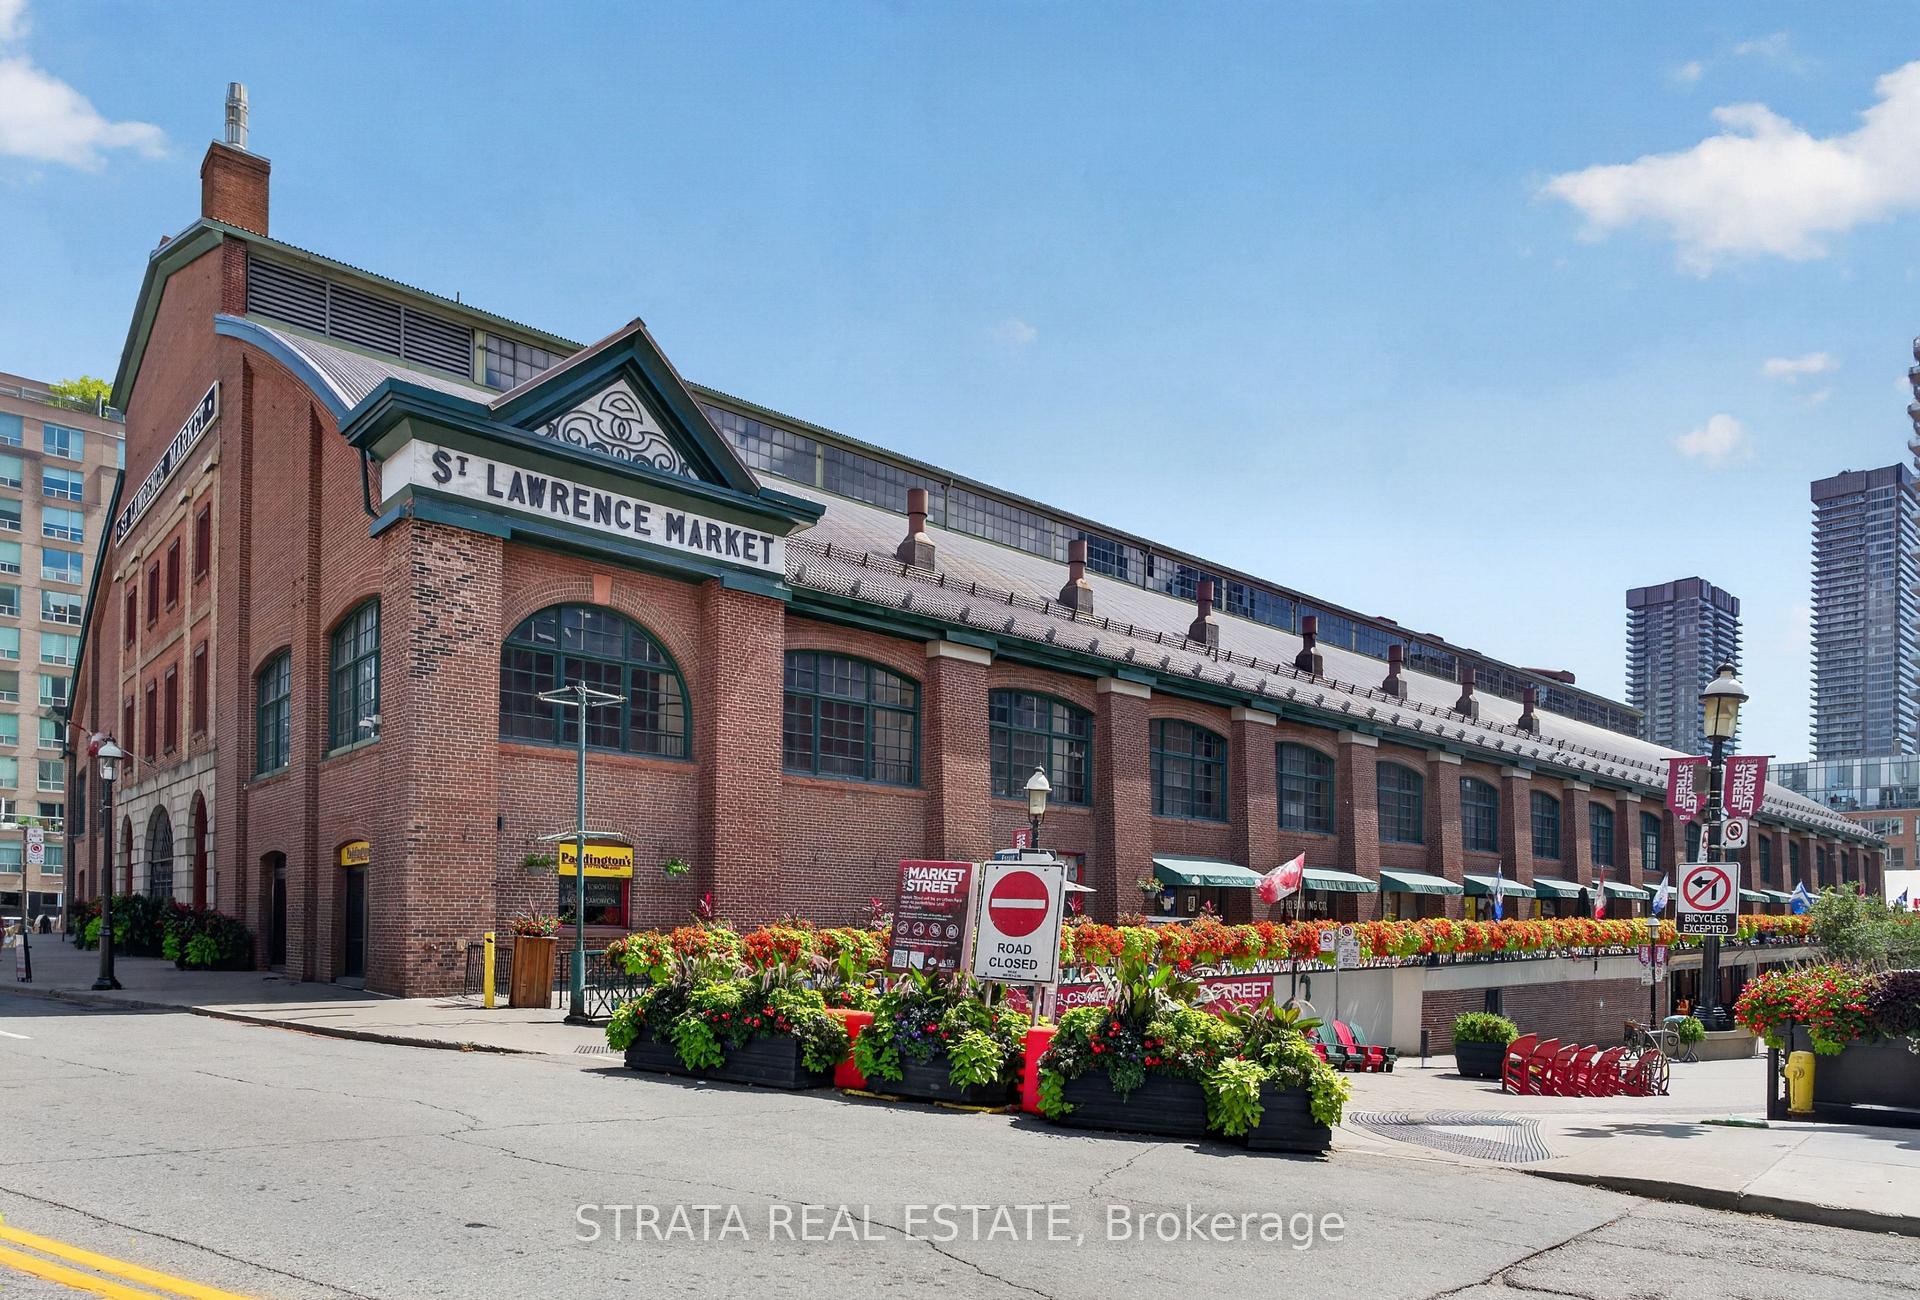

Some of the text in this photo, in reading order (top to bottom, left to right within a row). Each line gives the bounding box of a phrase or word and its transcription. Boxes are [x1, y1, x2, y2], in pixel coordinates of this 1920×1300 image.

[130, 460, 165, 525] LAWRENCE
[169, 401, 206, 471] MARKET
[486, 463, 652, 536] LAWRENCE
[665, 512, 775, 565] MARKET
[1674, 765, 1689, 810] STREET
[1731, 764, 1747, 810] STREET
[1741, 764, 1759, 816] MARKET
[561, 852, 632, 868] Padington's
[908, 867, 966, 882] MARKET
[906, 880, 959, 894] STREET
[1684, 914, 1728, 923] BICYCLES
[1683, 924, 1729, 934] EXCEPTED
[997, 942, 1032, 955] ROAD
[989, 957, 1038, 970] CLOSED
